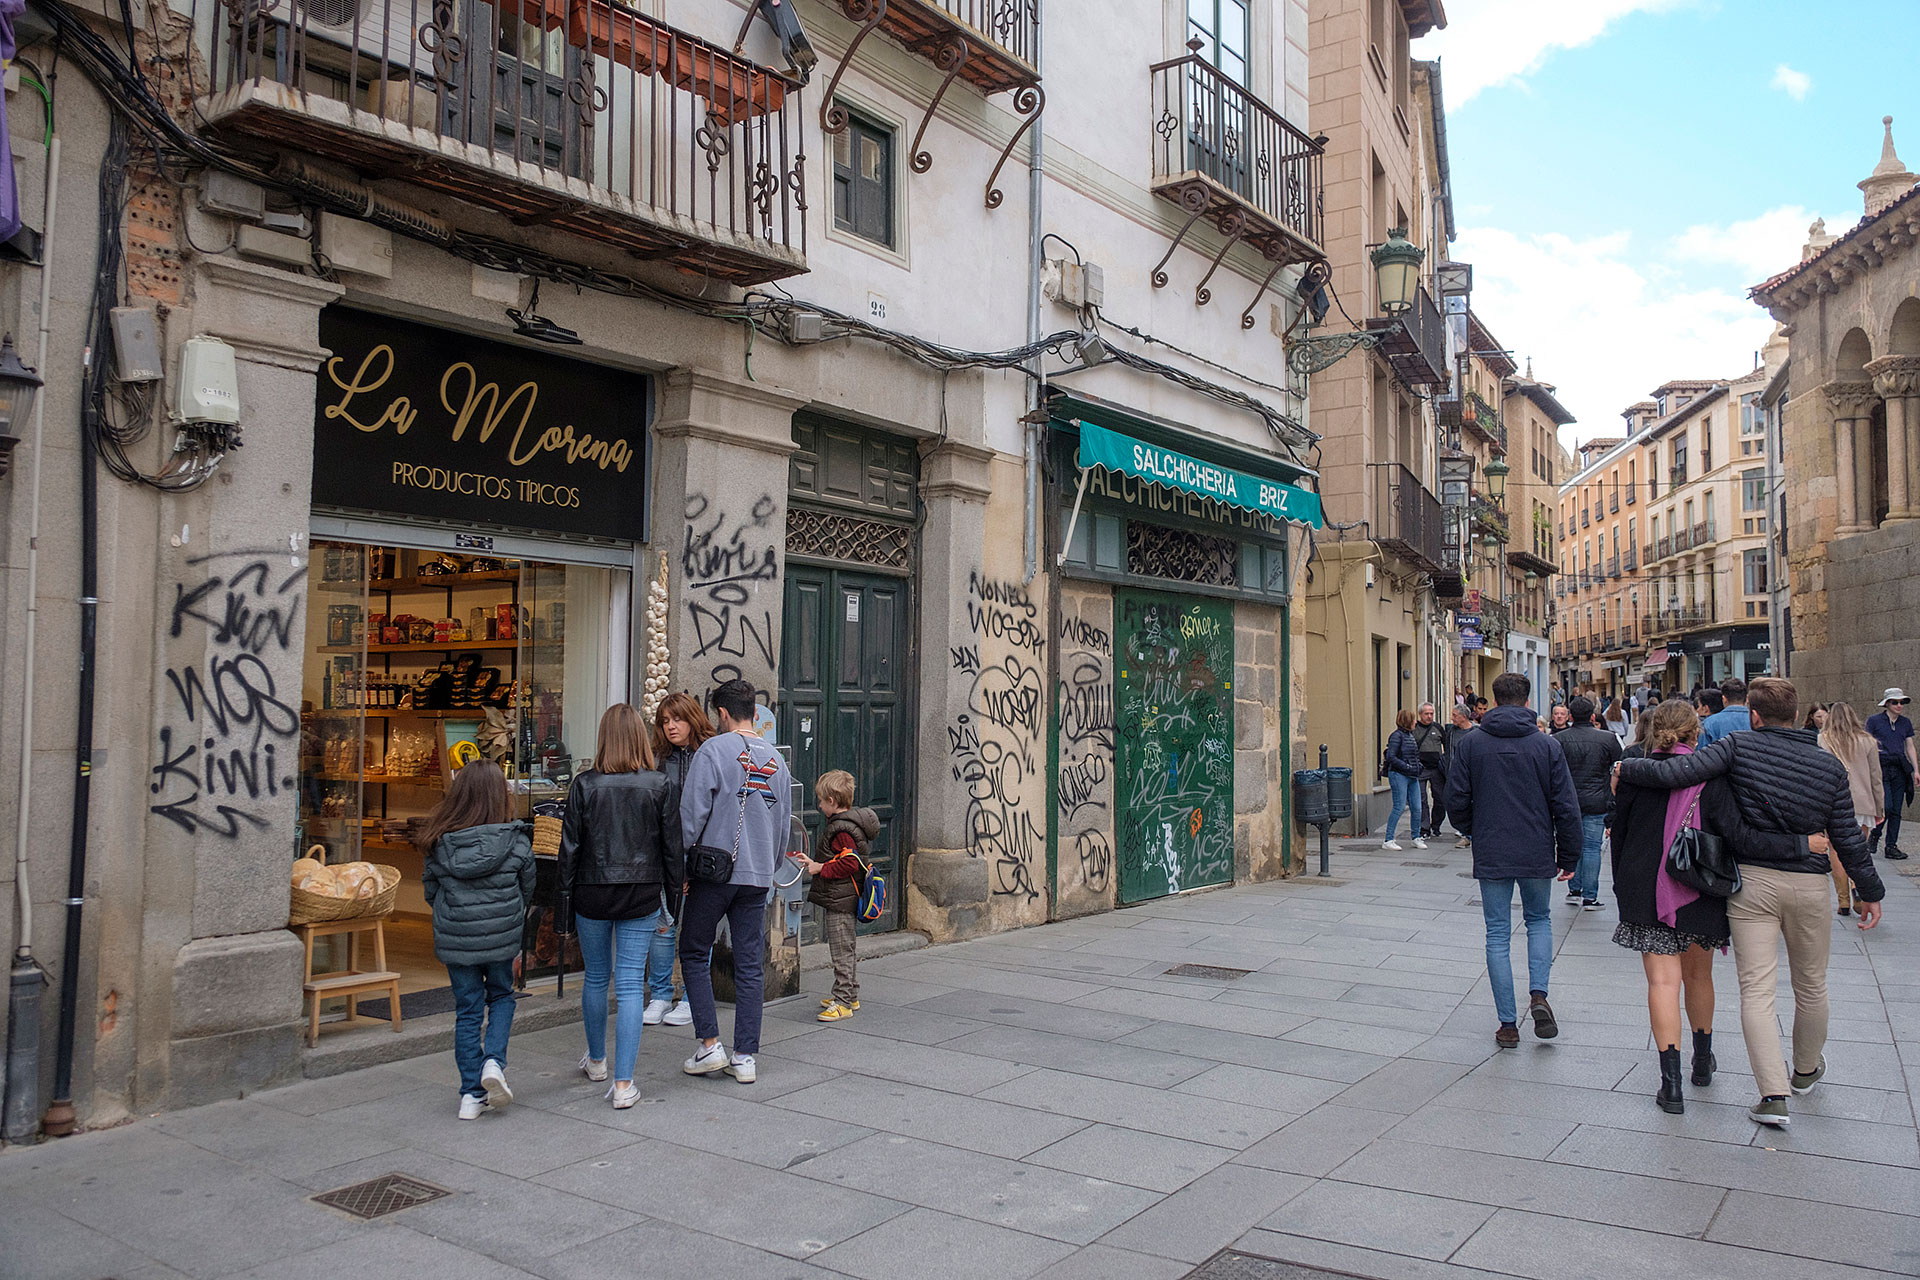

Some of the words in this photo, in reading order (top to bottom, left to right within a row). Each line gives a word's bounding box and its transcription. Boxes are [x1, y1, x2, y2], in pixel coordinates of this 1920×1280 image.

[871, 301, 886, 319] 28
[325, 344, 418, 434] La
[440, 362, 633, 472] Morena
[392, 461, 511, 500] PRODUCTOS
[1133, 444, 1238, 498] SALCHICHERIA
[1259, 484, 1288, 512] BRIZ
[1458, 616, 1475, 624] PILAS
